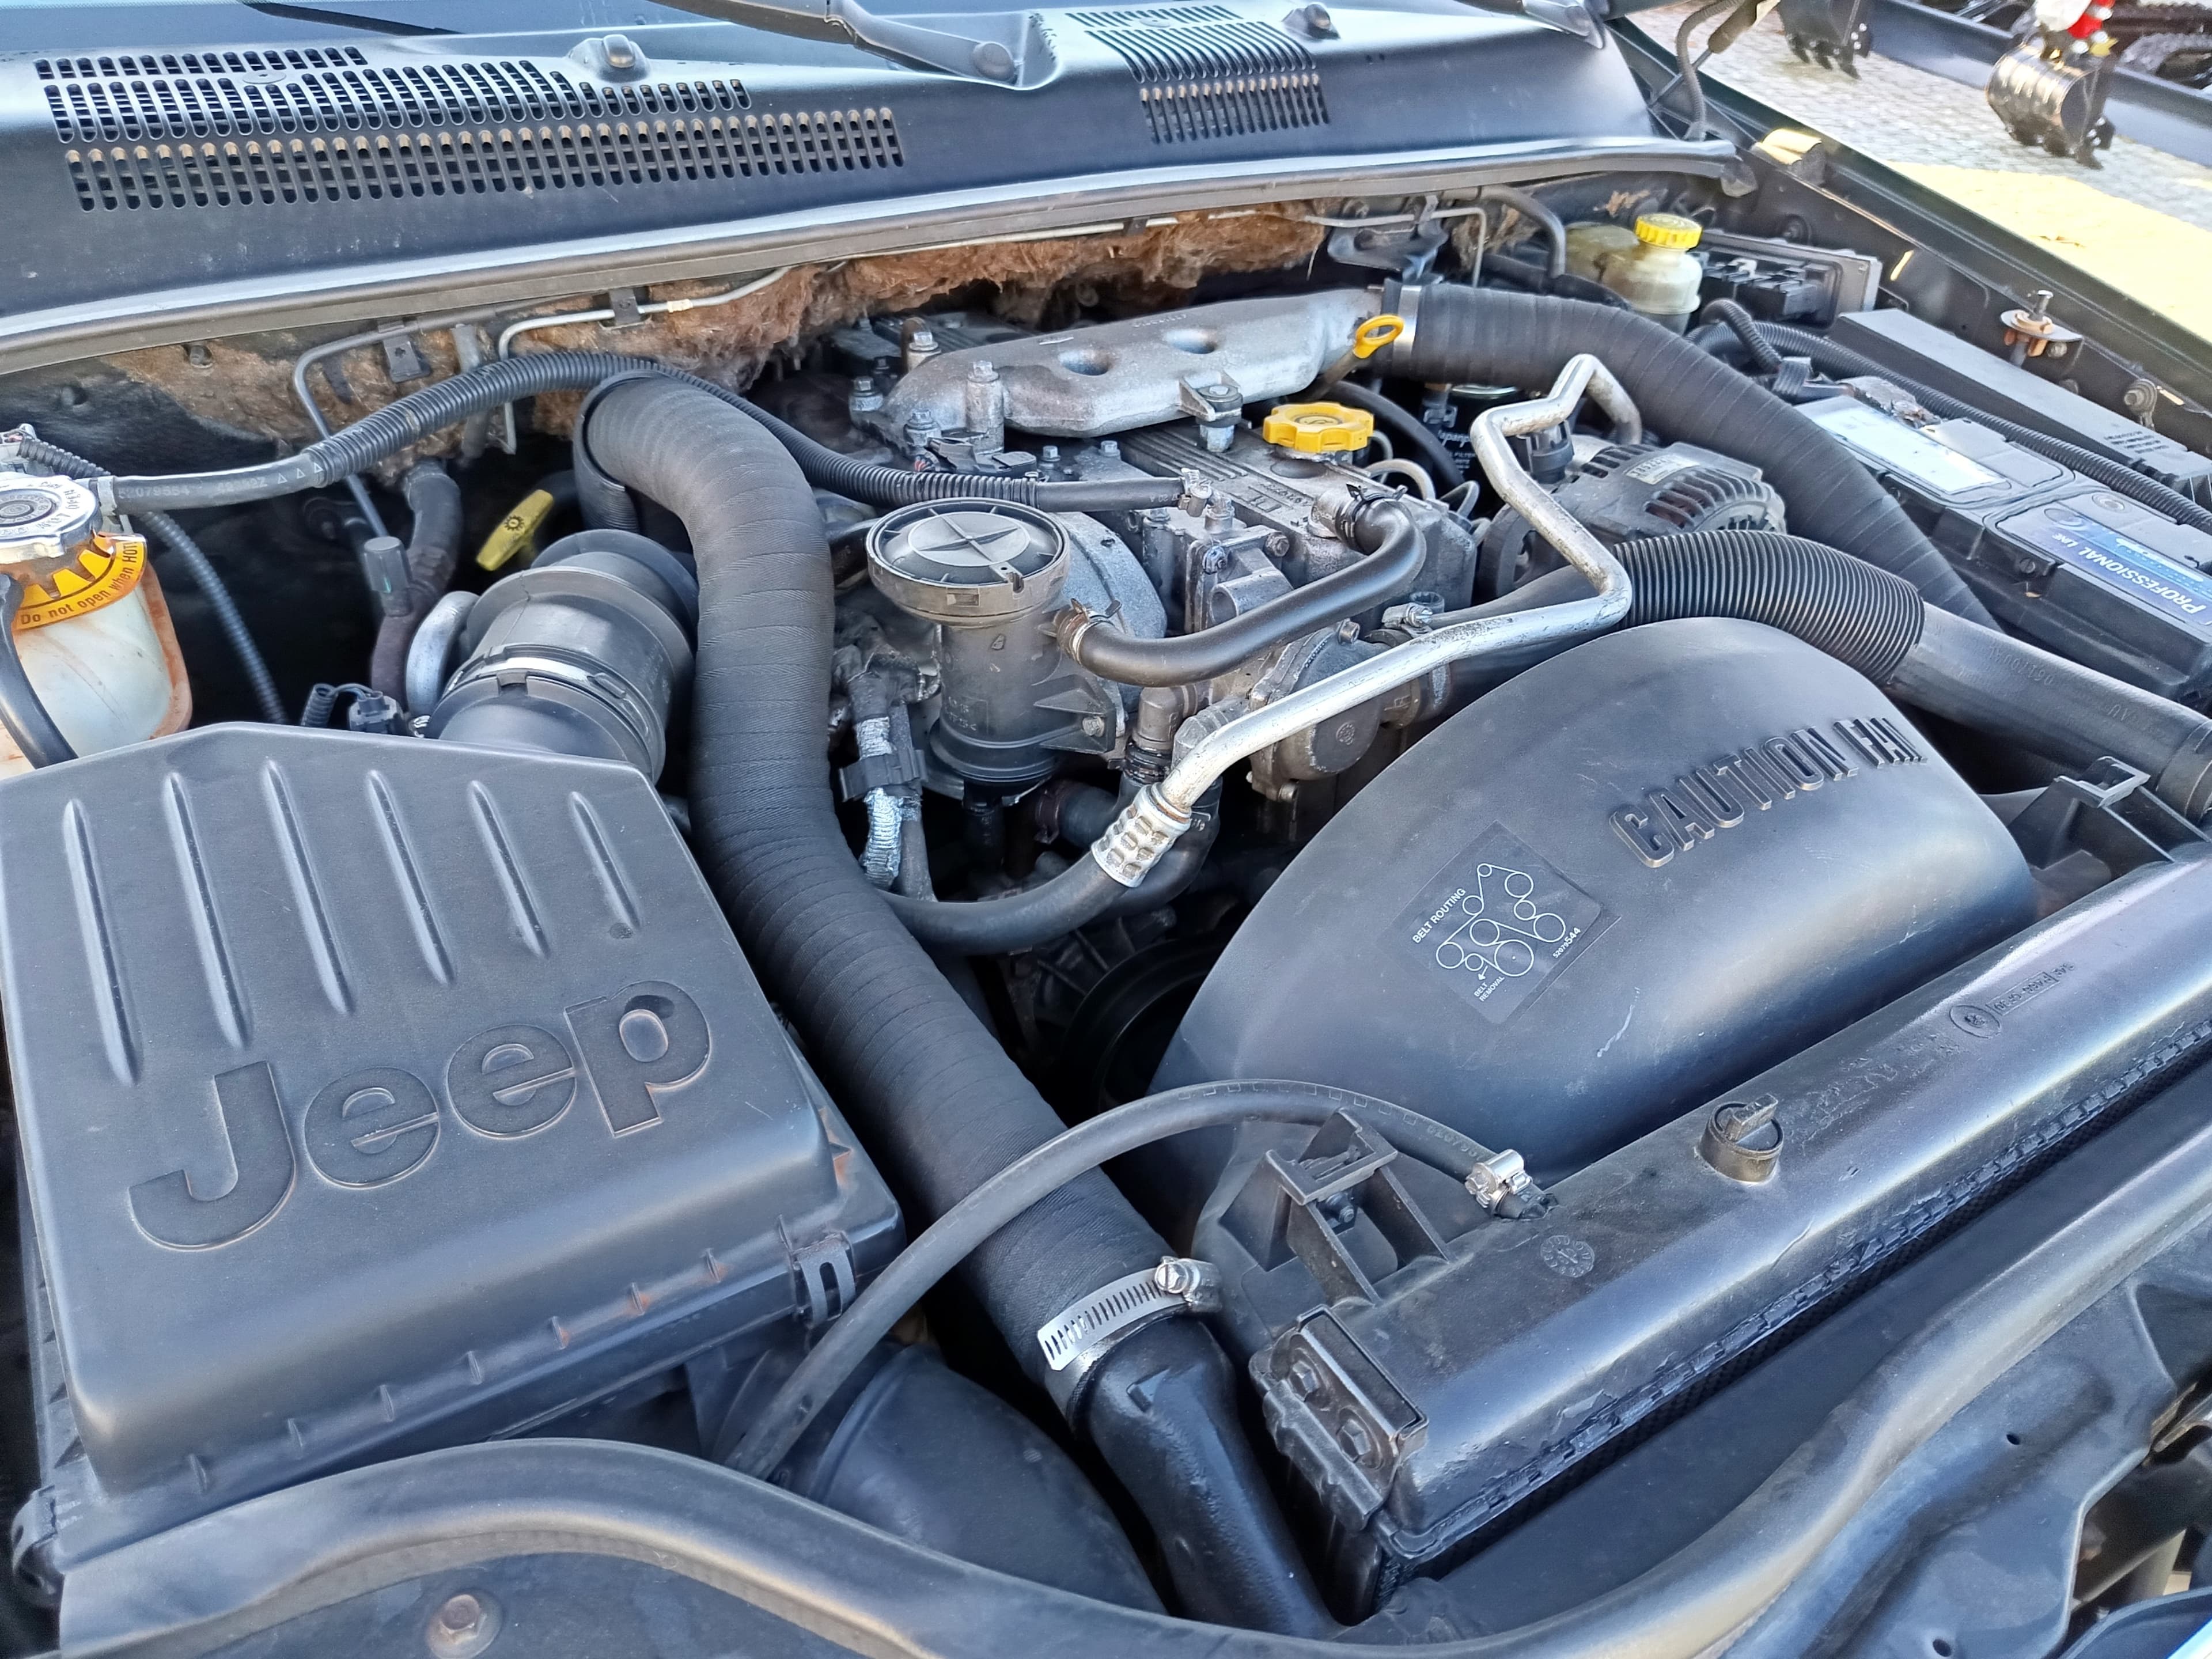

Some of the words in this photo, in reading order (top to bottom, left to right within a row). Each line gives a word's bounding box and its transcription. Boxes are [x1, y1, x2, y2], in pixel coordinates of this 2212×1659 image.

[2052, 533, 2078, 548] LINE
[21, 613, 41, 625] Do
[48, 604, 74, 618] not
[77, 589, 111, 609] open
[108, 566, 135, 592] when
[2078, 546, 2207, 614] PROFESSIONAL
[1609, 726, 1858, 868] CAUTION
[1833, 718, 1927, 768] FAN
[1412, 922, 1434, 944] BELT
[1430, 888, 1466, 925] ROUTING
[1553, 926, 1581, 959] 52079544
[1474, 982, 1488, 998] BELT
[1479, 975, 1505, 1002] REMOVAL
[127, 980, 713, 1253] Jeep
